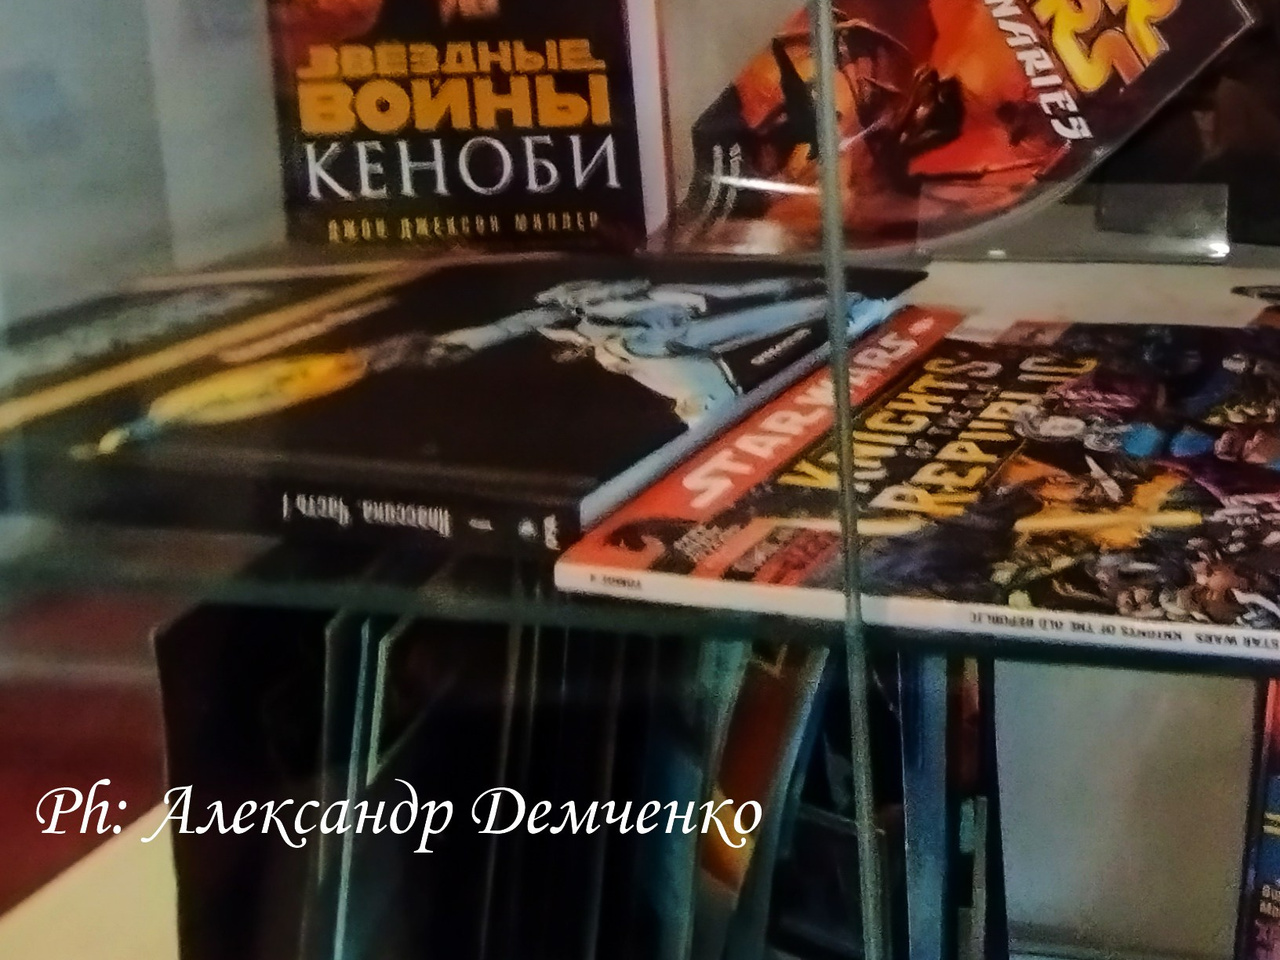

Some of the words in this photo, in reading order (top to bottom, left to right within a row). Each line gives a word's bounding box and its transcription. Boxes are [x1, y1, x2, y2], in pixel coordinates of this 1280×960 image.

[298, 74, 612, 133] ВОЙНЫ
[306, 133, 623, 201] КЕНОБИ
[682, 408, 828, 509] STAR
